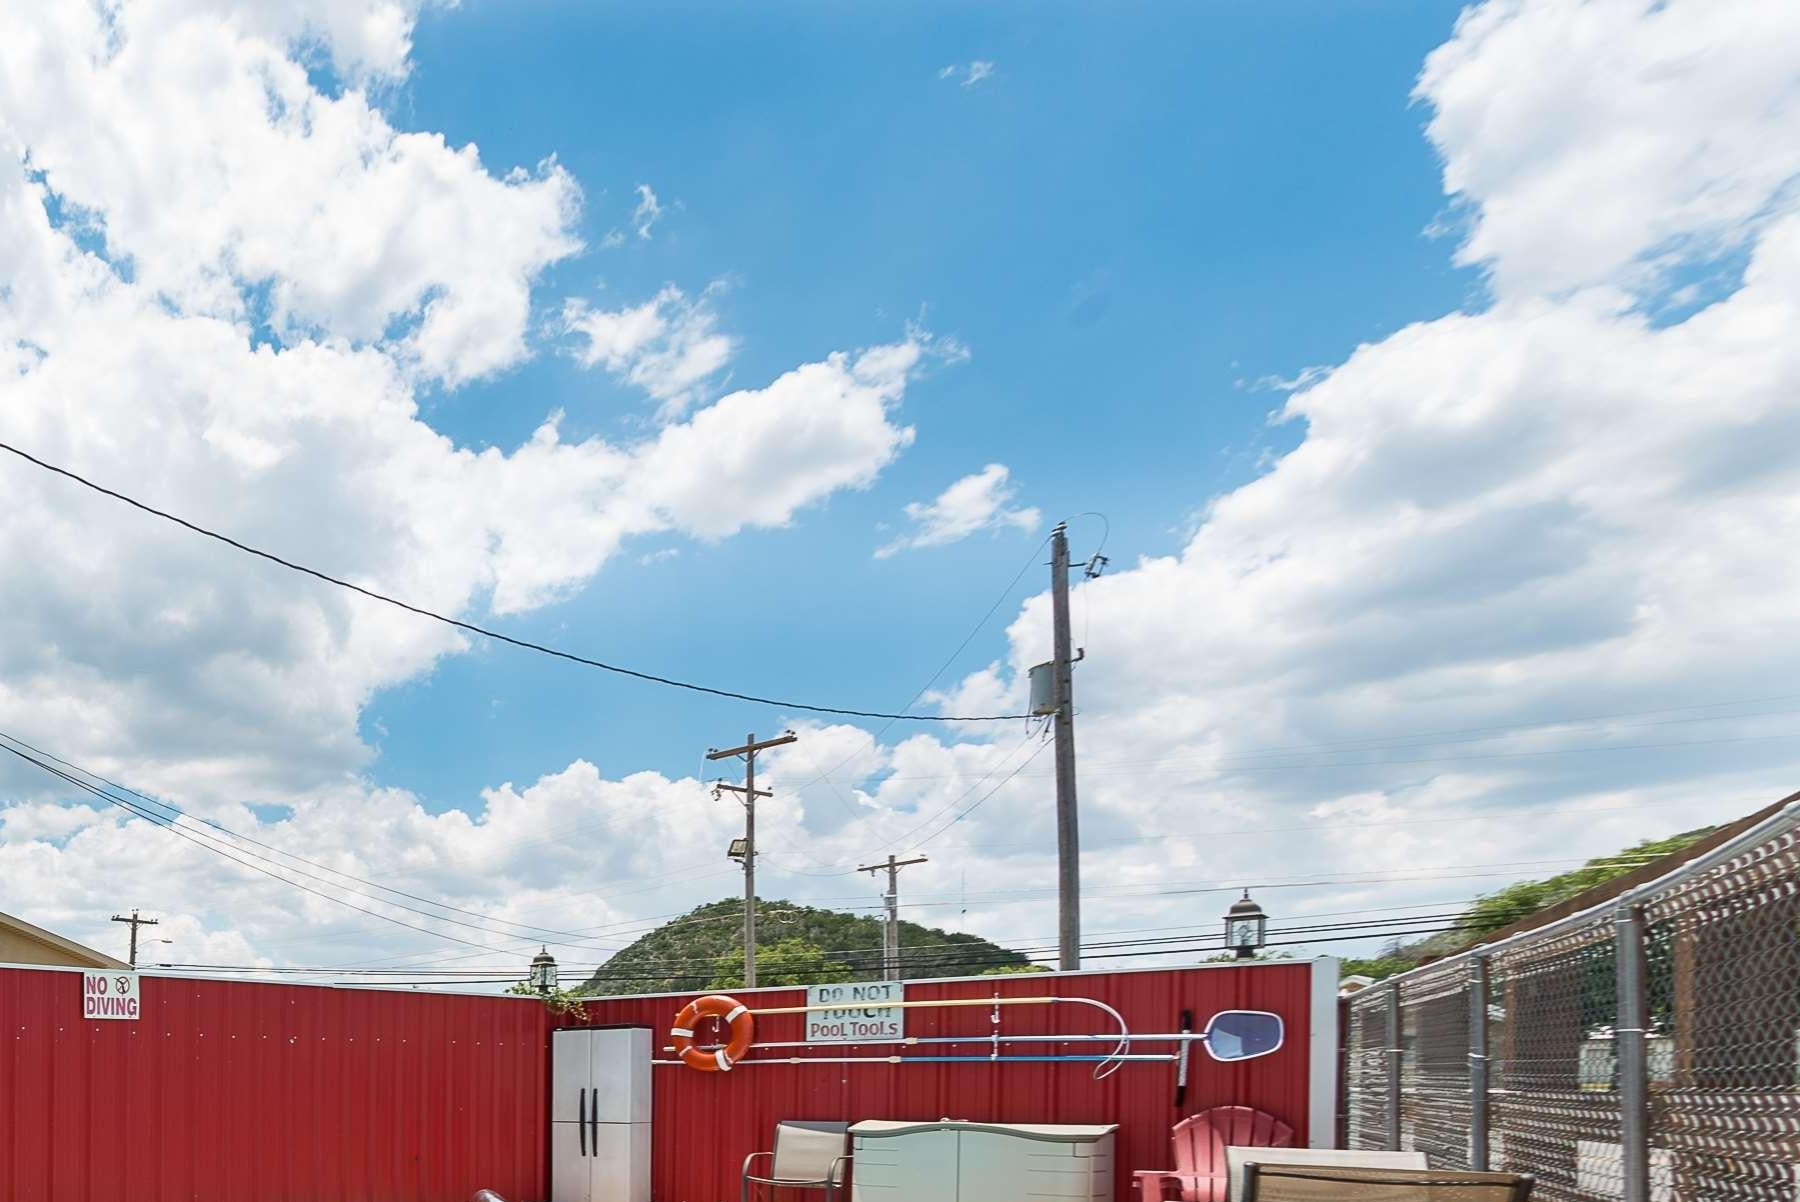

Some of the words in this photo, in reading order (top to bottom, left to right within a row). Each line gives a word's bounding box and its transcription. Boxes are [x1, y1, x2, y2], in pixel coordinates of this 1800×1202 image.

[86, 976, 108, 995] NO
[819, 987, 844, 1003] DO
[852, 985, 893, 1001] NOT
[86, 996, 137, 1016] DIVING
